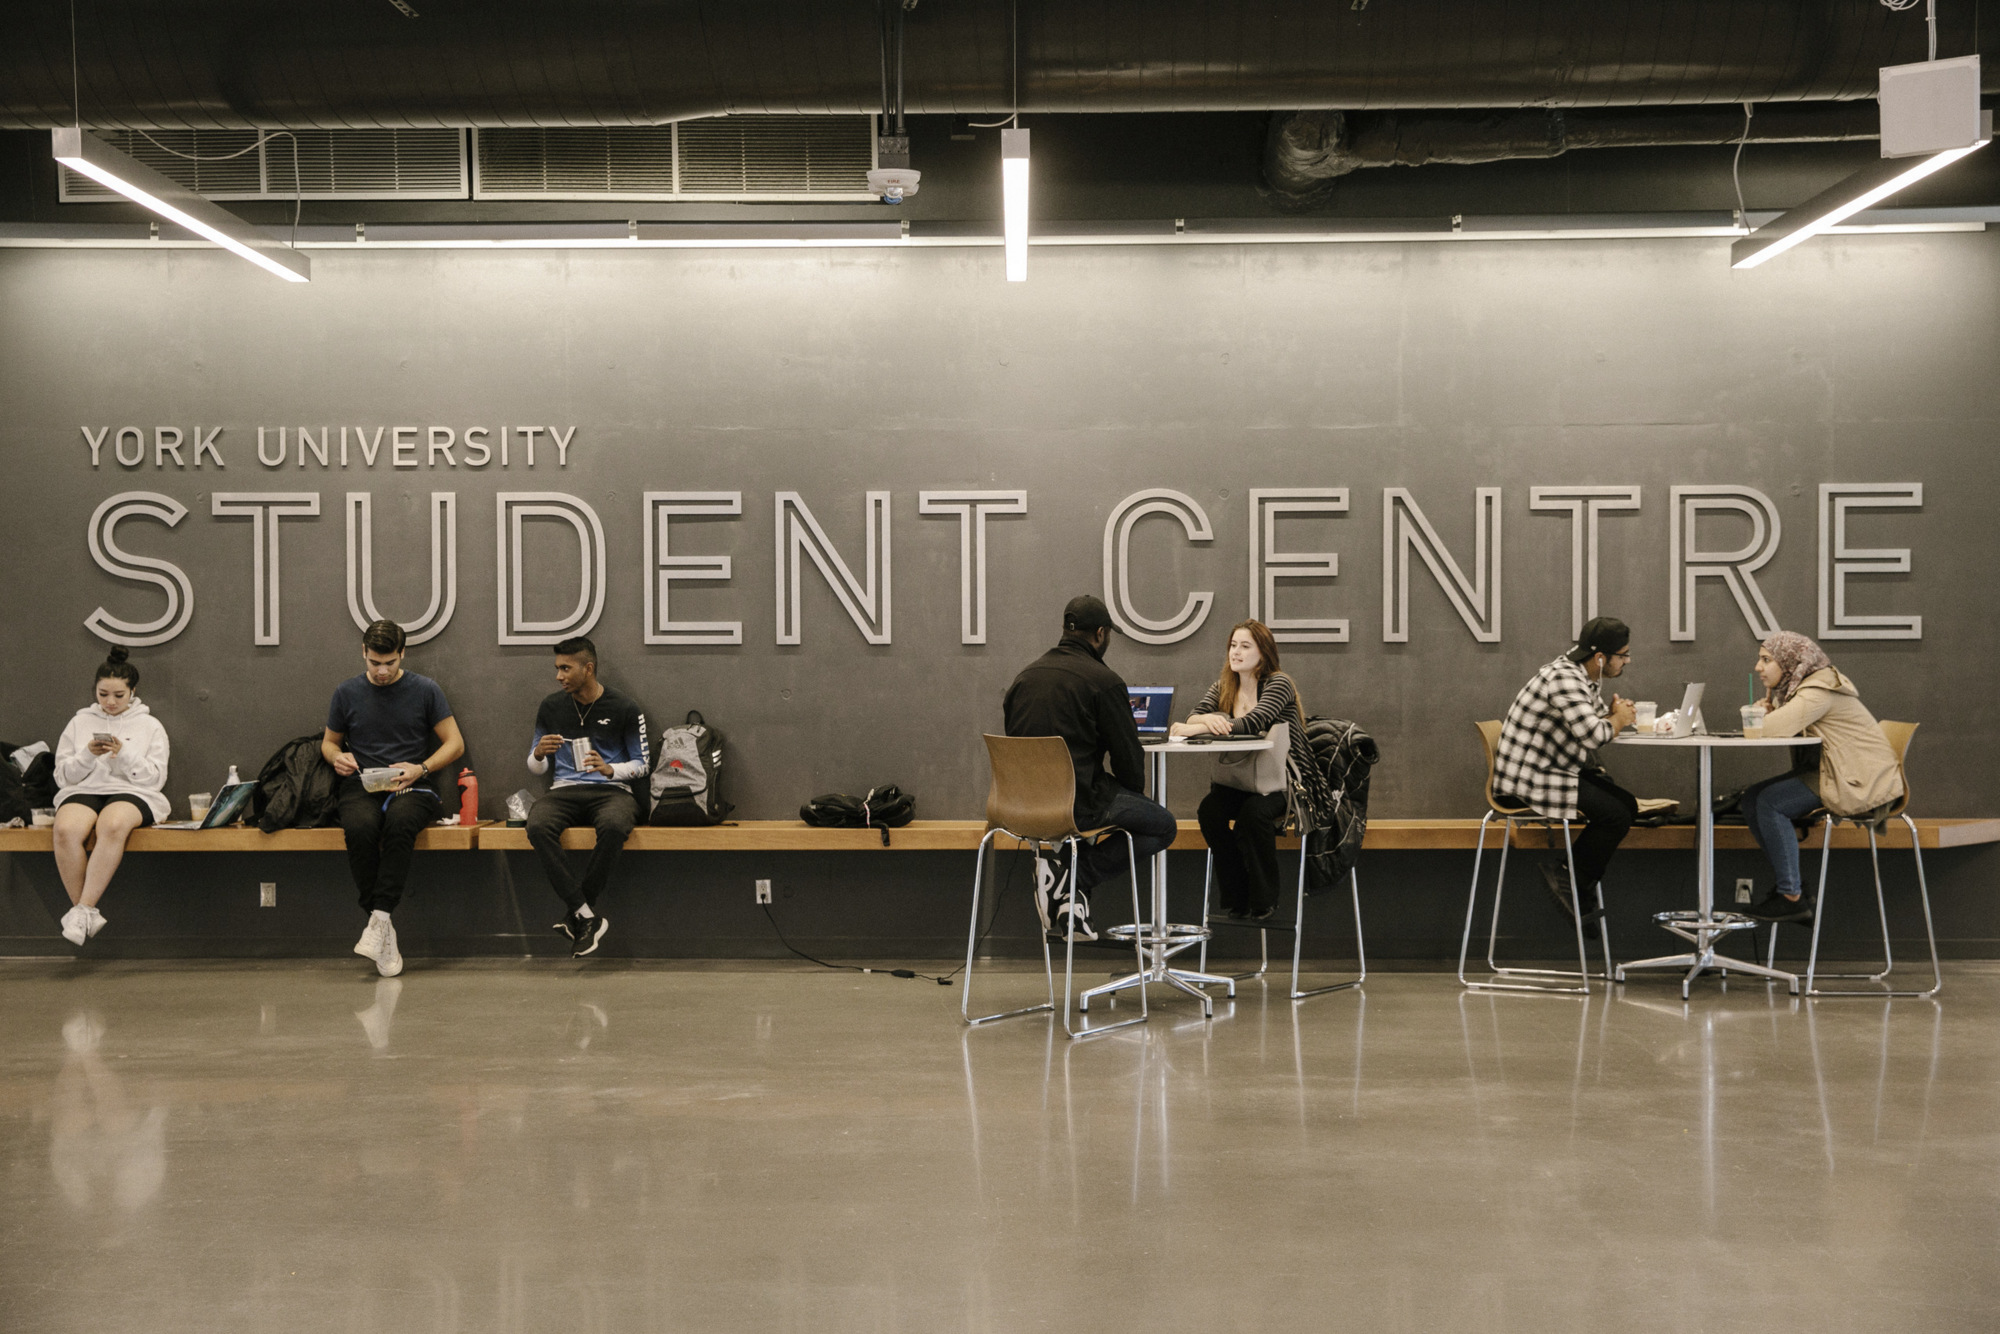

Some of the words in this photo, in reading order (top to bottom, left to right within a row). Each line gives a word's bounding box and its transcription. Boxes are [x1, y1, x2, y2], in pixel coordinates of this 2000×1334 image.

[80, 425, 225, 467] YORK
[257, 425, 577, 467] UNIVERSITY
[83, 489, 1028, 647] STUDENT
[1102, 482, 1923, 645] CENTRE
